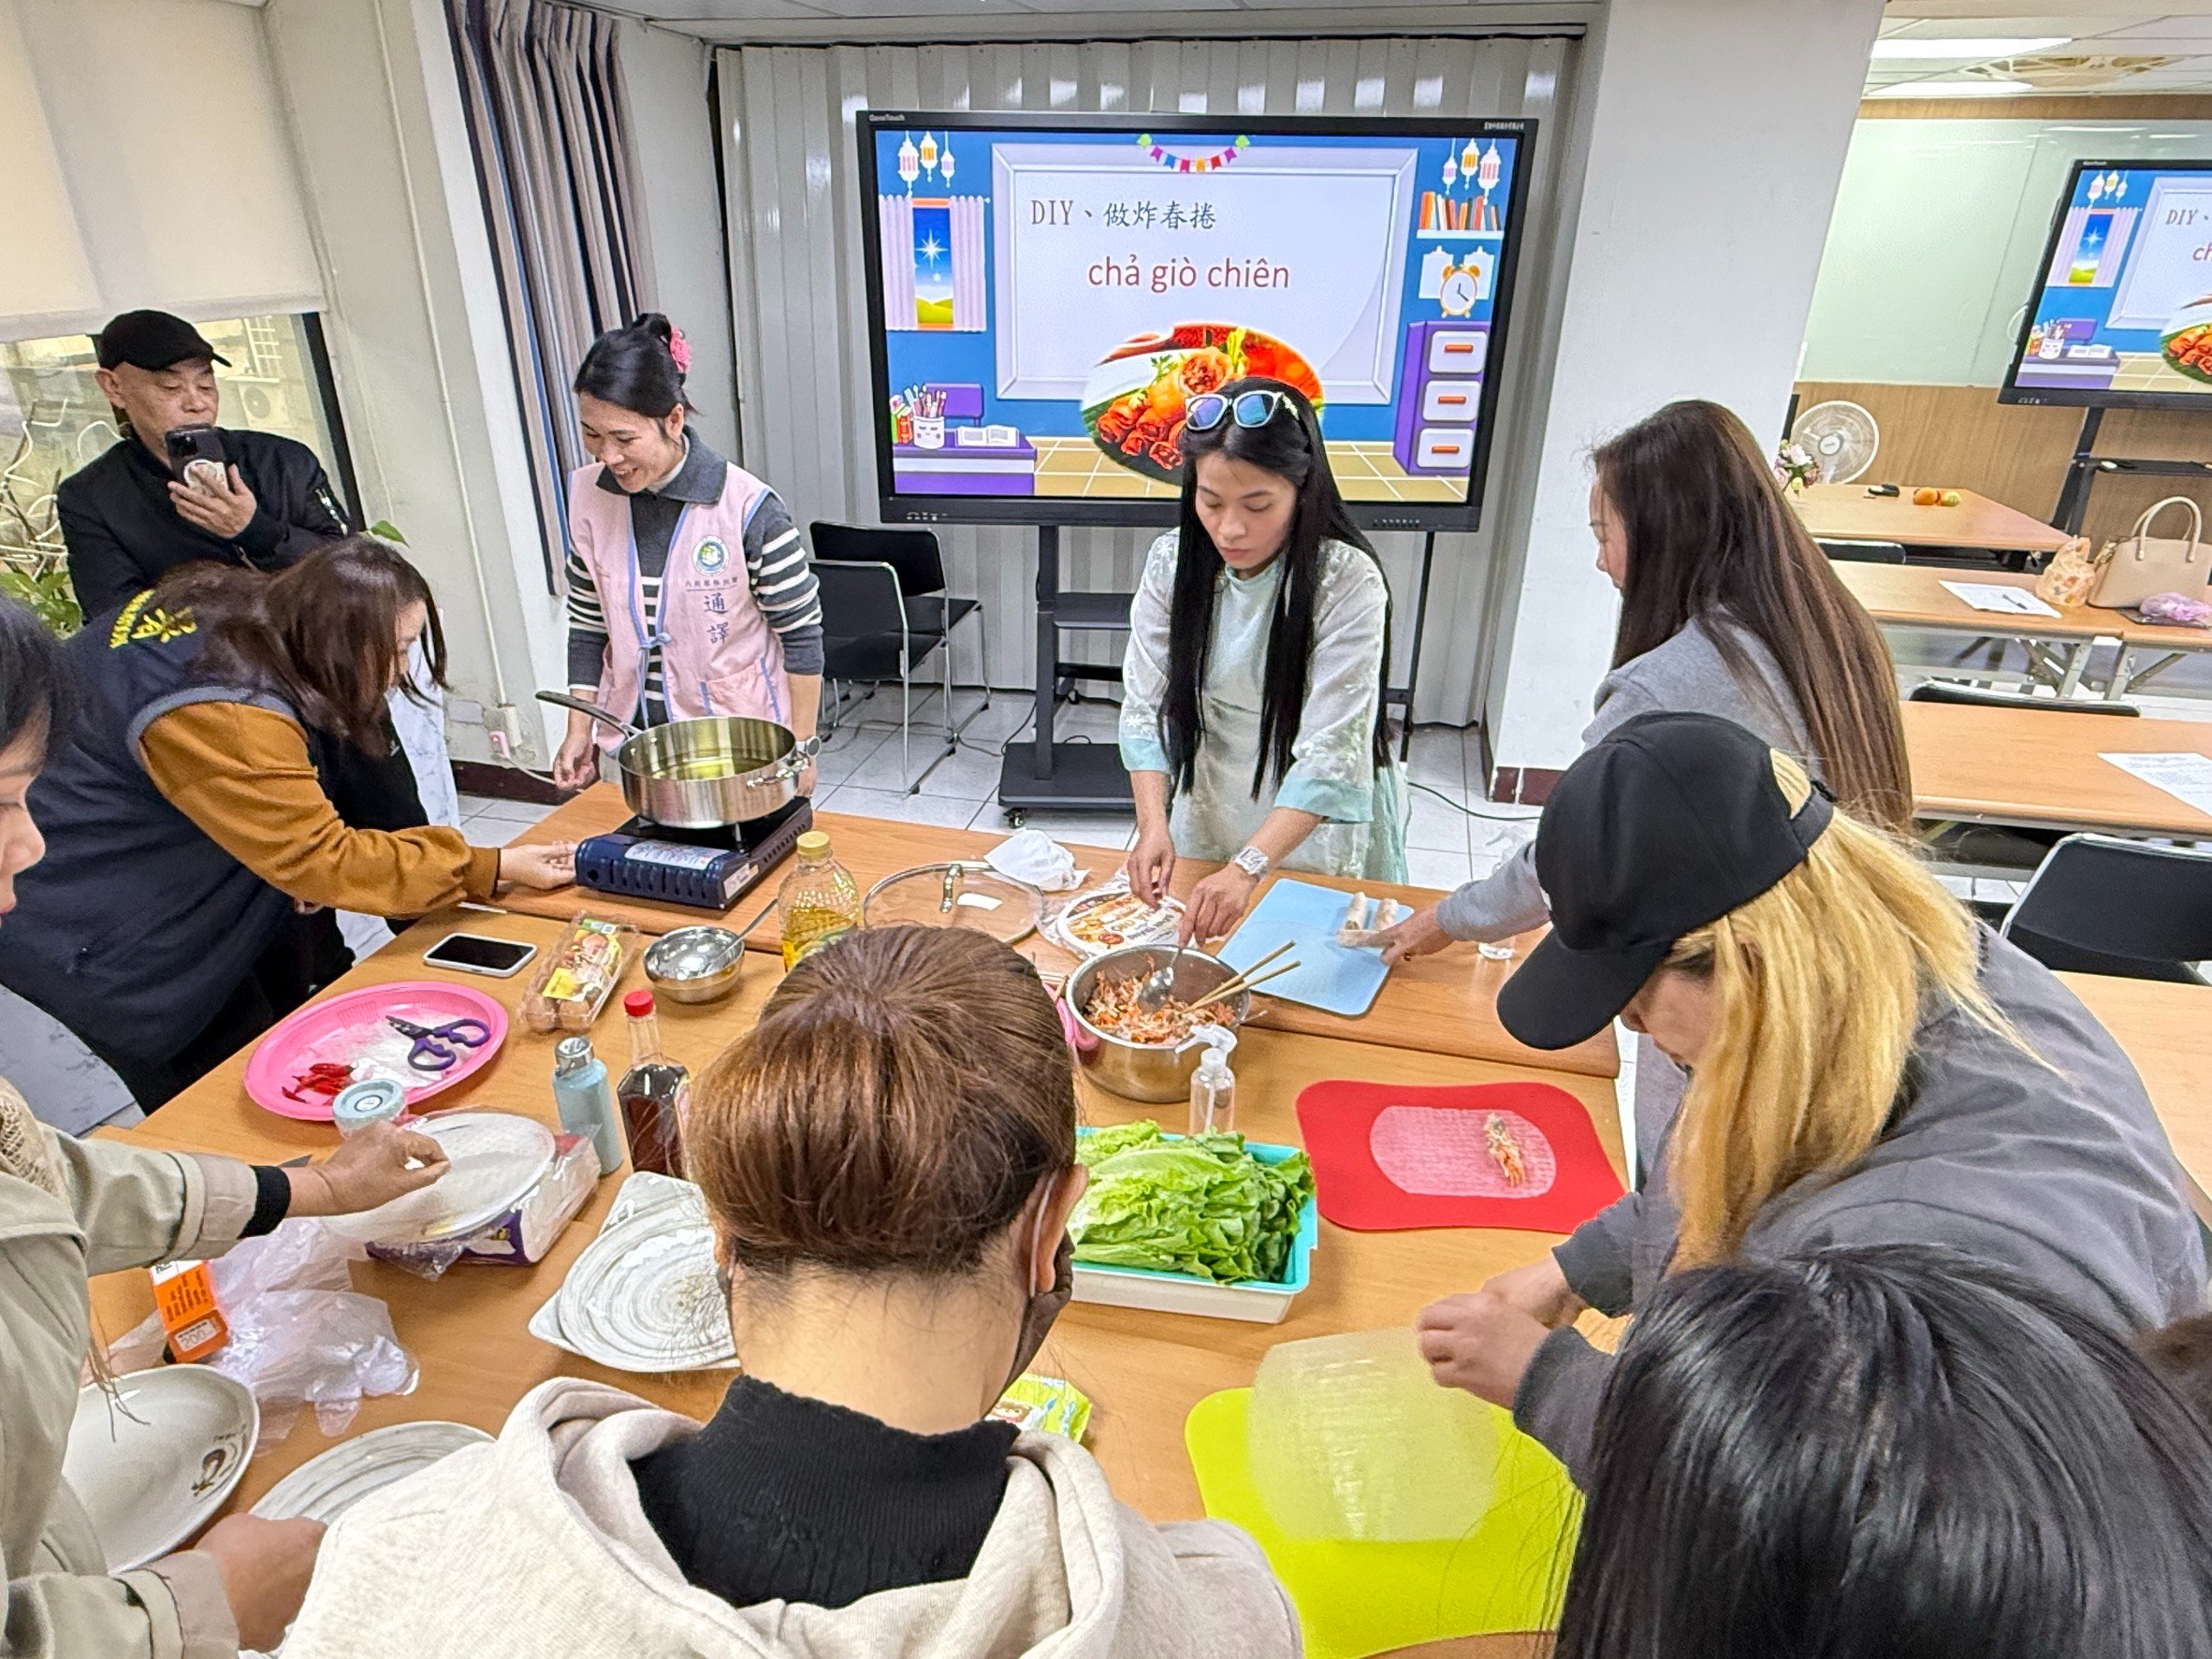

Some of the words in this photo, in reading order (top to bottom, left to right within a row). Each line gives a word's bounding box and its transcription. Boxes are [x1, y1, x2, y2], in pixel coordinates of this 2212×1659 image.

[1088, 254, 1141, 286] chả
[1151, 256, 1197, 293] giò
[1207, 257, 1289, 288] chiên
[704, 592, 729, 644] 通譯
